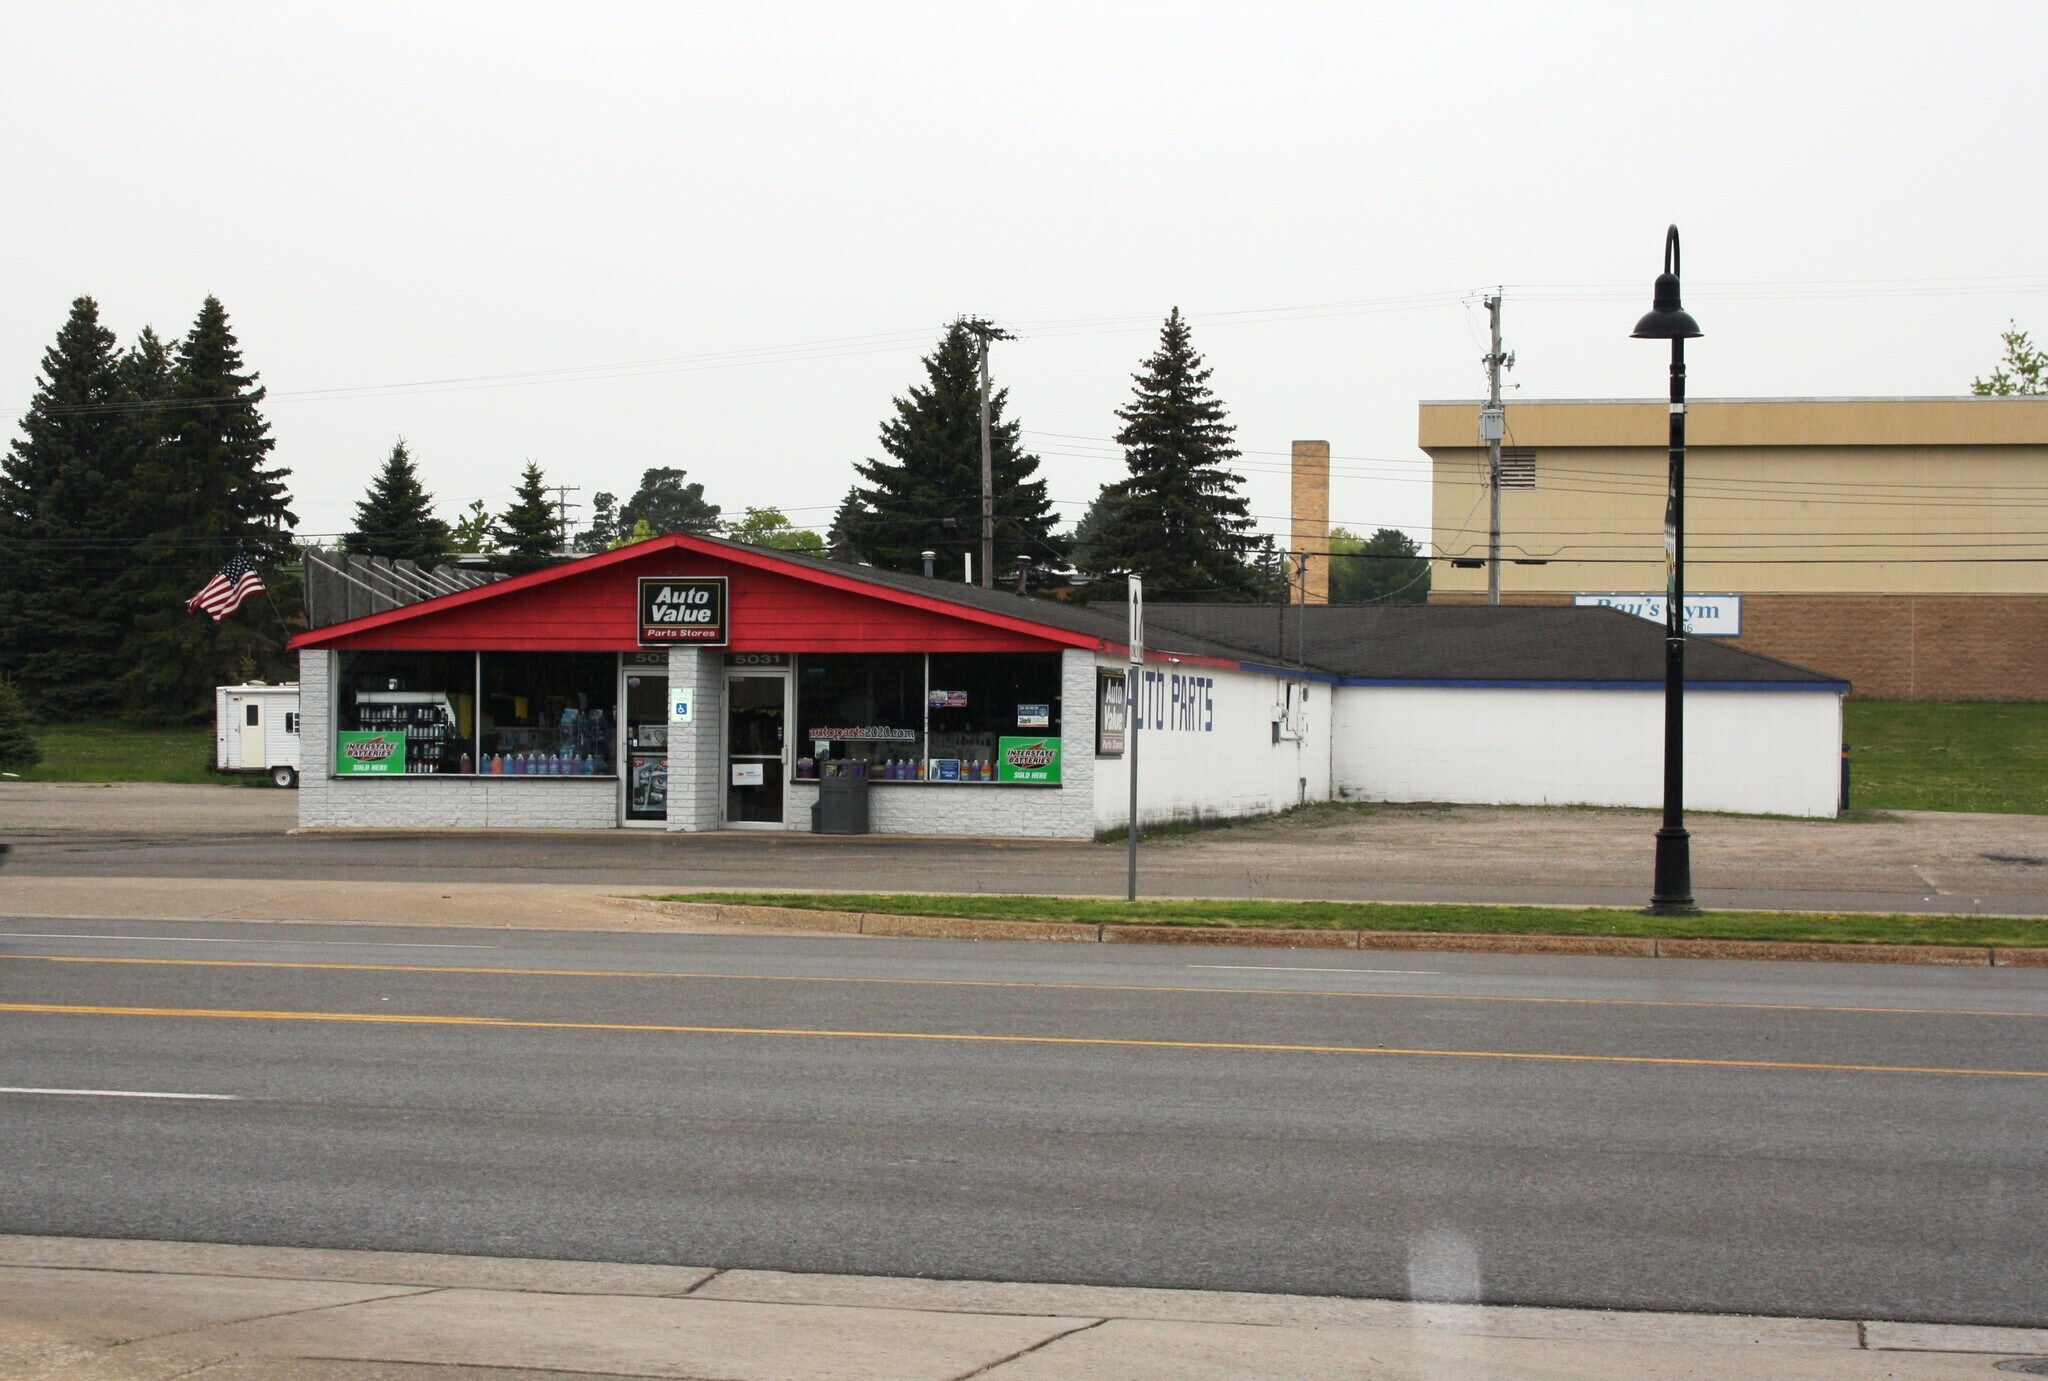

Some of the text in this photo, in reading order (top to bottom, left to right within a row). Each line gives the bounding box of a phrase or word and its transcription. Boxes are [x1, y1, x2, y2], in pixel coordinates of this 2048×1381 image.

[655, 587, 709, 604] Auto
[652, 605, 711, 622] Value
[1667, 604, 1719, 622] ym
[648, 629, 715, 637] Parts Stores
[635, 653, 669, 664] 503
[735, 654, 780, 664] 5031
[1106, 678, 1123, 704] Auto
[1172, 674, 1213, 731] PARTS
[1104, 705, 1123, 731] Value
[809, 725, 915, 740] autoparts2020.com
[1007, 749, 1055, 757] INTERSTATE
[1013, 771, 1048, 779] SOLD HERE
